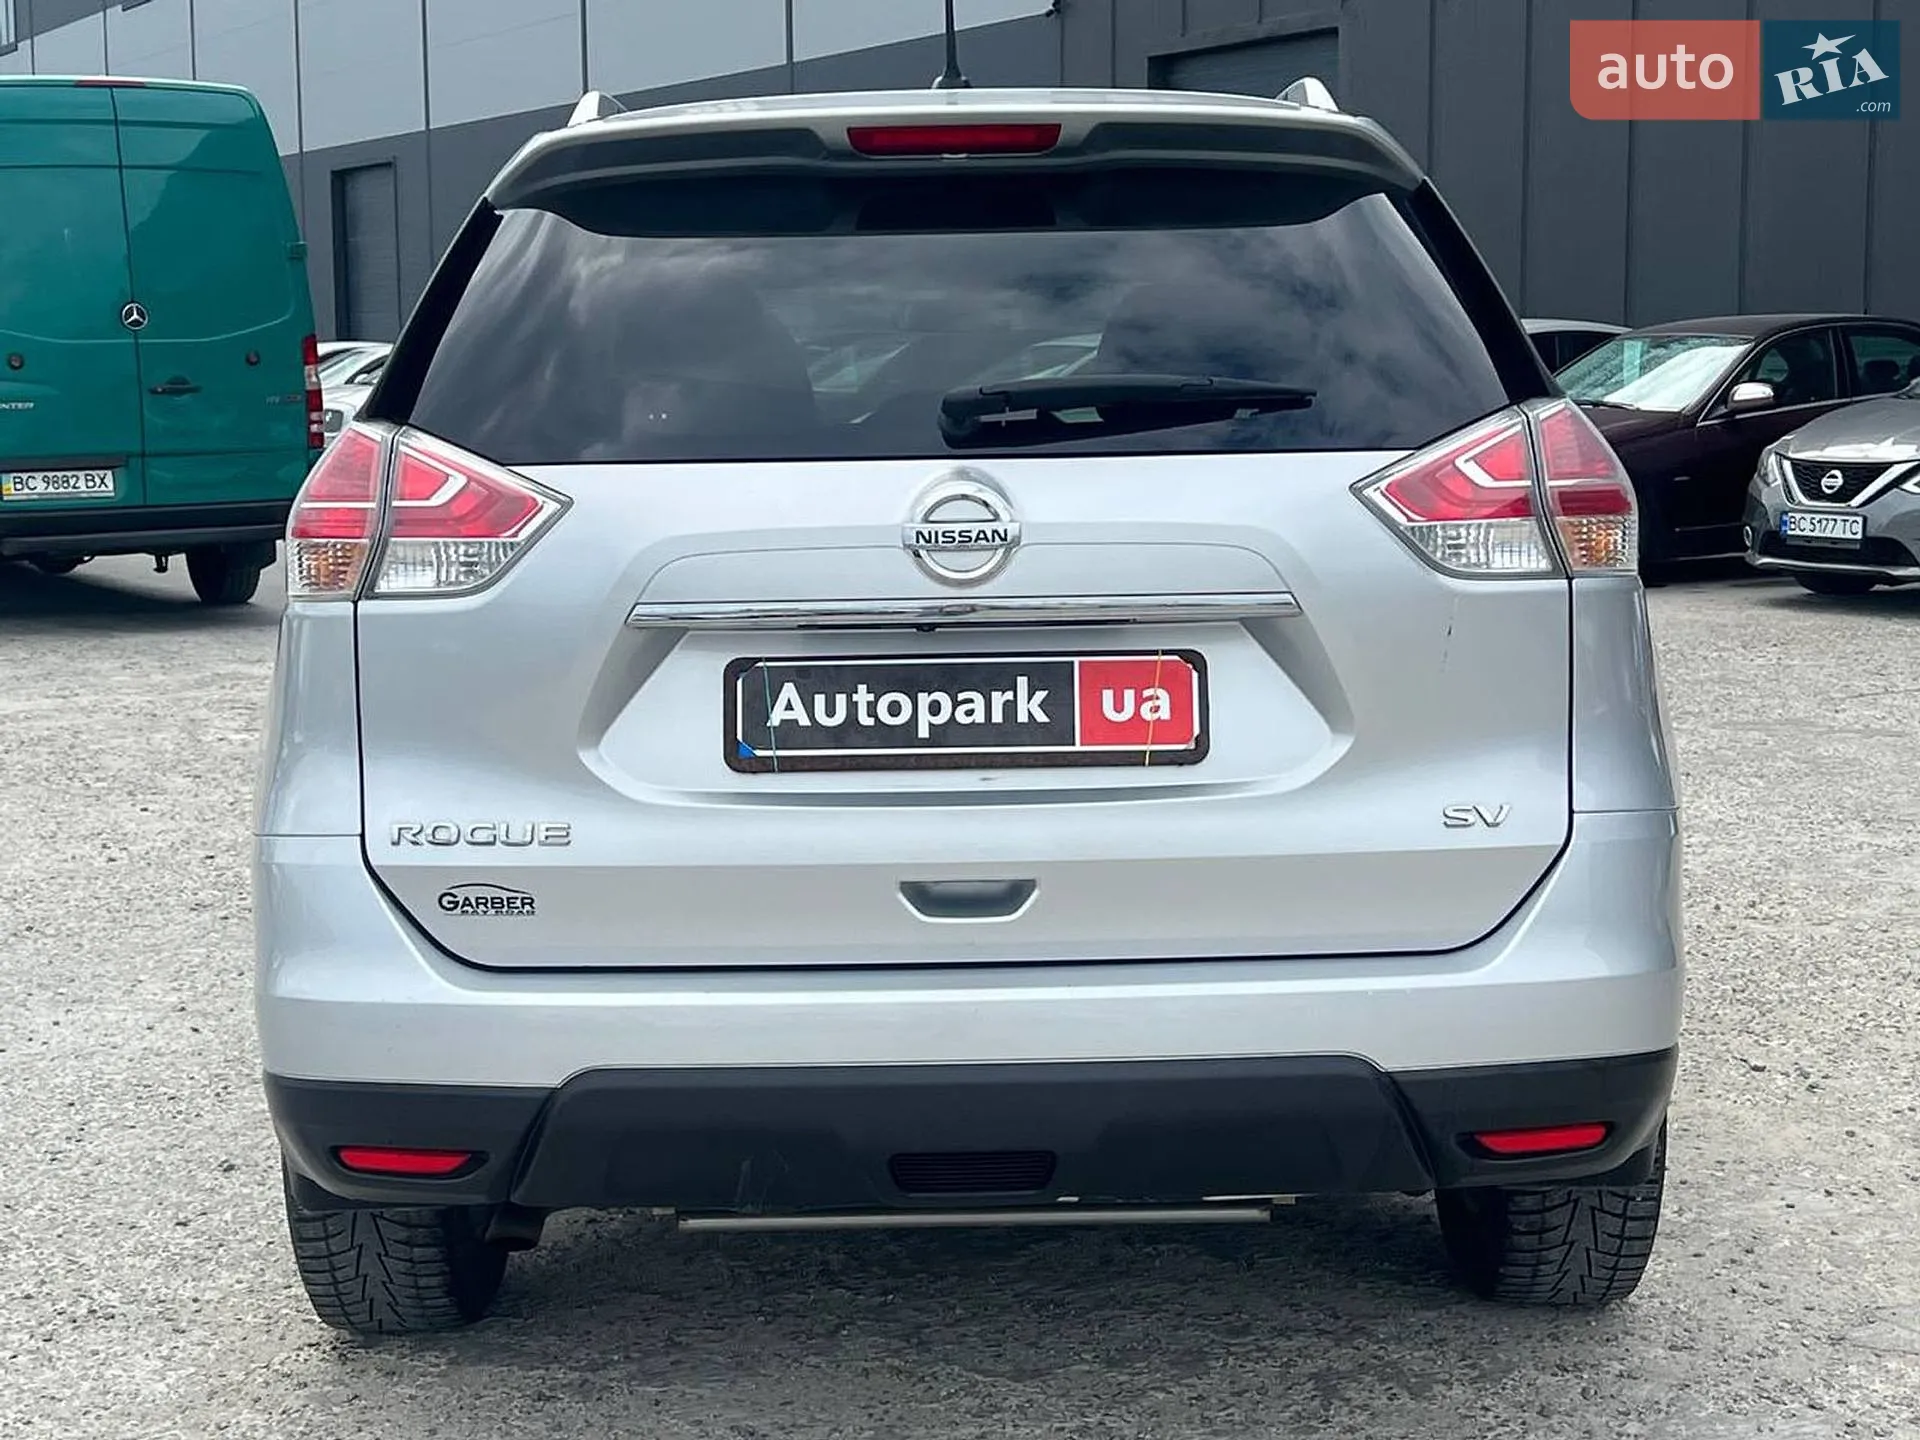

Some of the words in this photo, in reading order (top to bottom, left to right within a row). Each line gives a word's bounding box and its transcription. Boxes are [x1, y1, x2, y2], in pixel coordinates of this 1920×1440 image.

[12, 475, 38, 491] BC
[41, 474, 81, 490] 9882
[84, 473, 109, 489] BX
[1789, 515, 1806, 532] BC
[1809, 517, 1838, 534] 5177
[1840, 519, 1860, 535] TC
[915, 528, 1008, 544] NISSAN
[766, 676, 1050, 738] Autopark
[1101, 687, 1172, 721] ua
[1442, 803, 1511, 828] SV
[390, 822, 572, 846] ROGUE
[438, 892, 536, 911] GARBER
